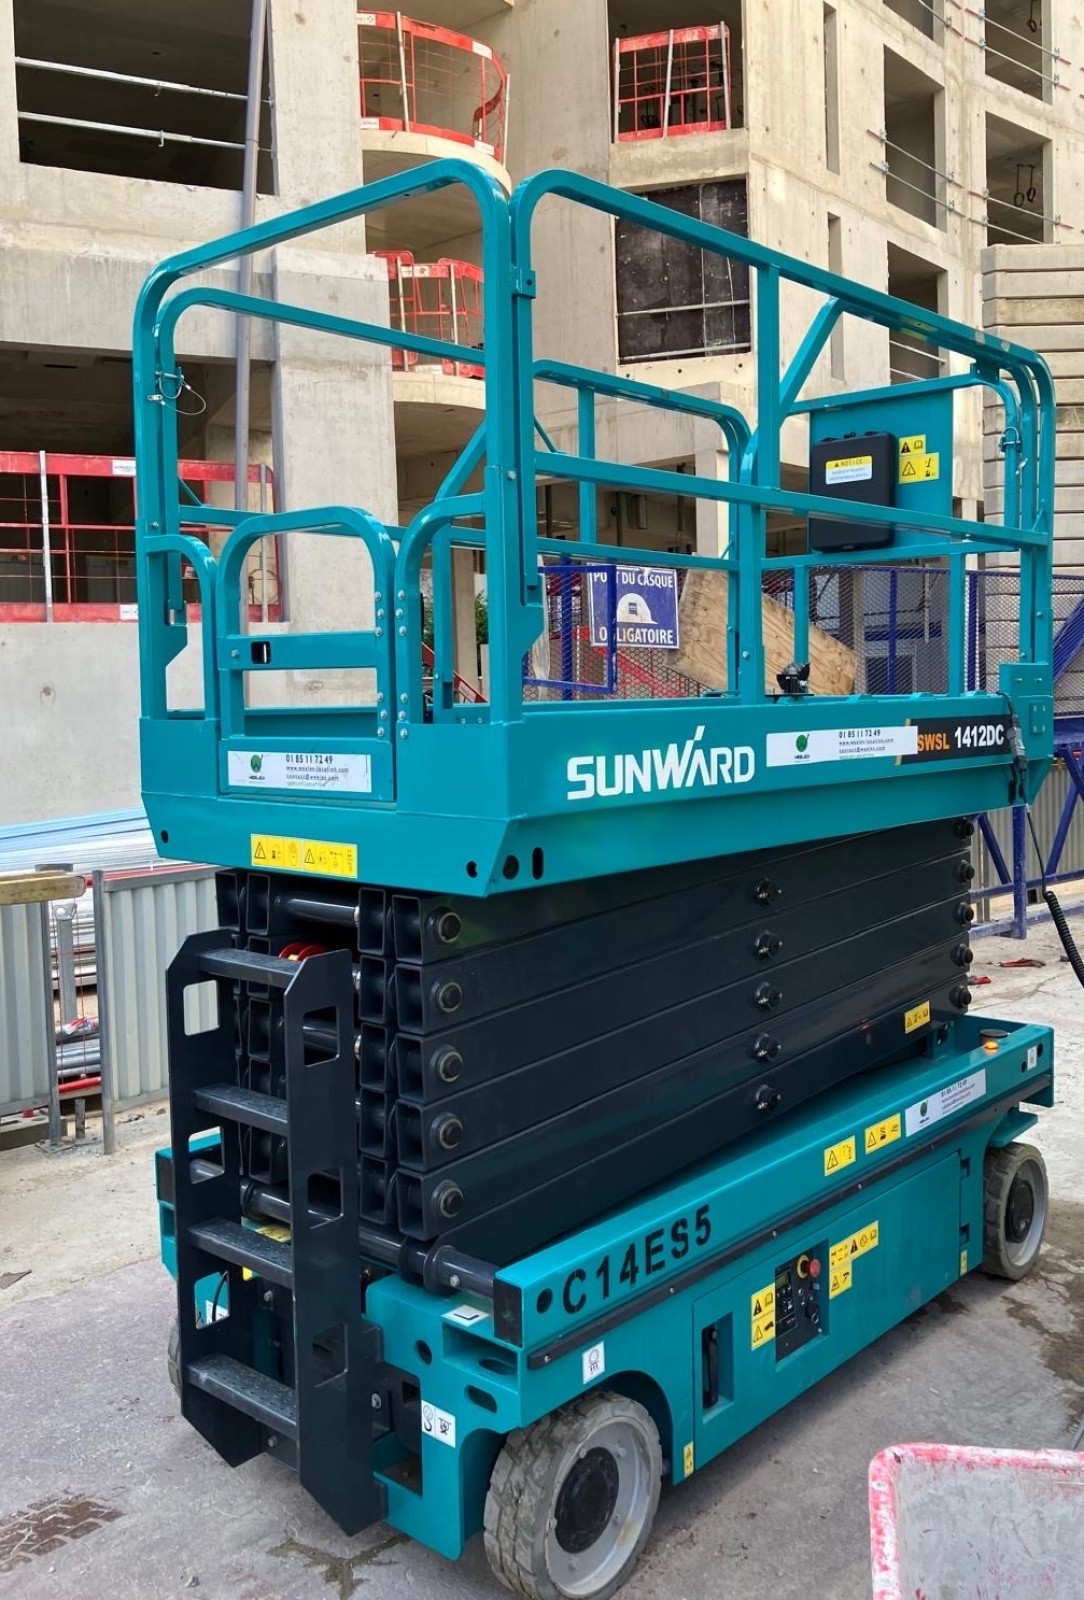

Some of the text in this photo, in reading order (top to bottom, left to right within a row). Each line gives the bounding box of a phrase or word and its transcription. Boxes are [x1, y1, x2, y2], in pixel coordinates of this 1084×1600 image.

[593, 571, 673, 588] POT DU CASQUE
[599, 626, 673, 644] OLIGATOIRE
[917, 724, 1004, 752] SWSL 1412DC
[286, 754, 293, 763] 01
[295, 754, 304, 763] 85
[567, 725, 755, 800] SUNWARD
[563, 1204, 711, 1314] C14ES5
